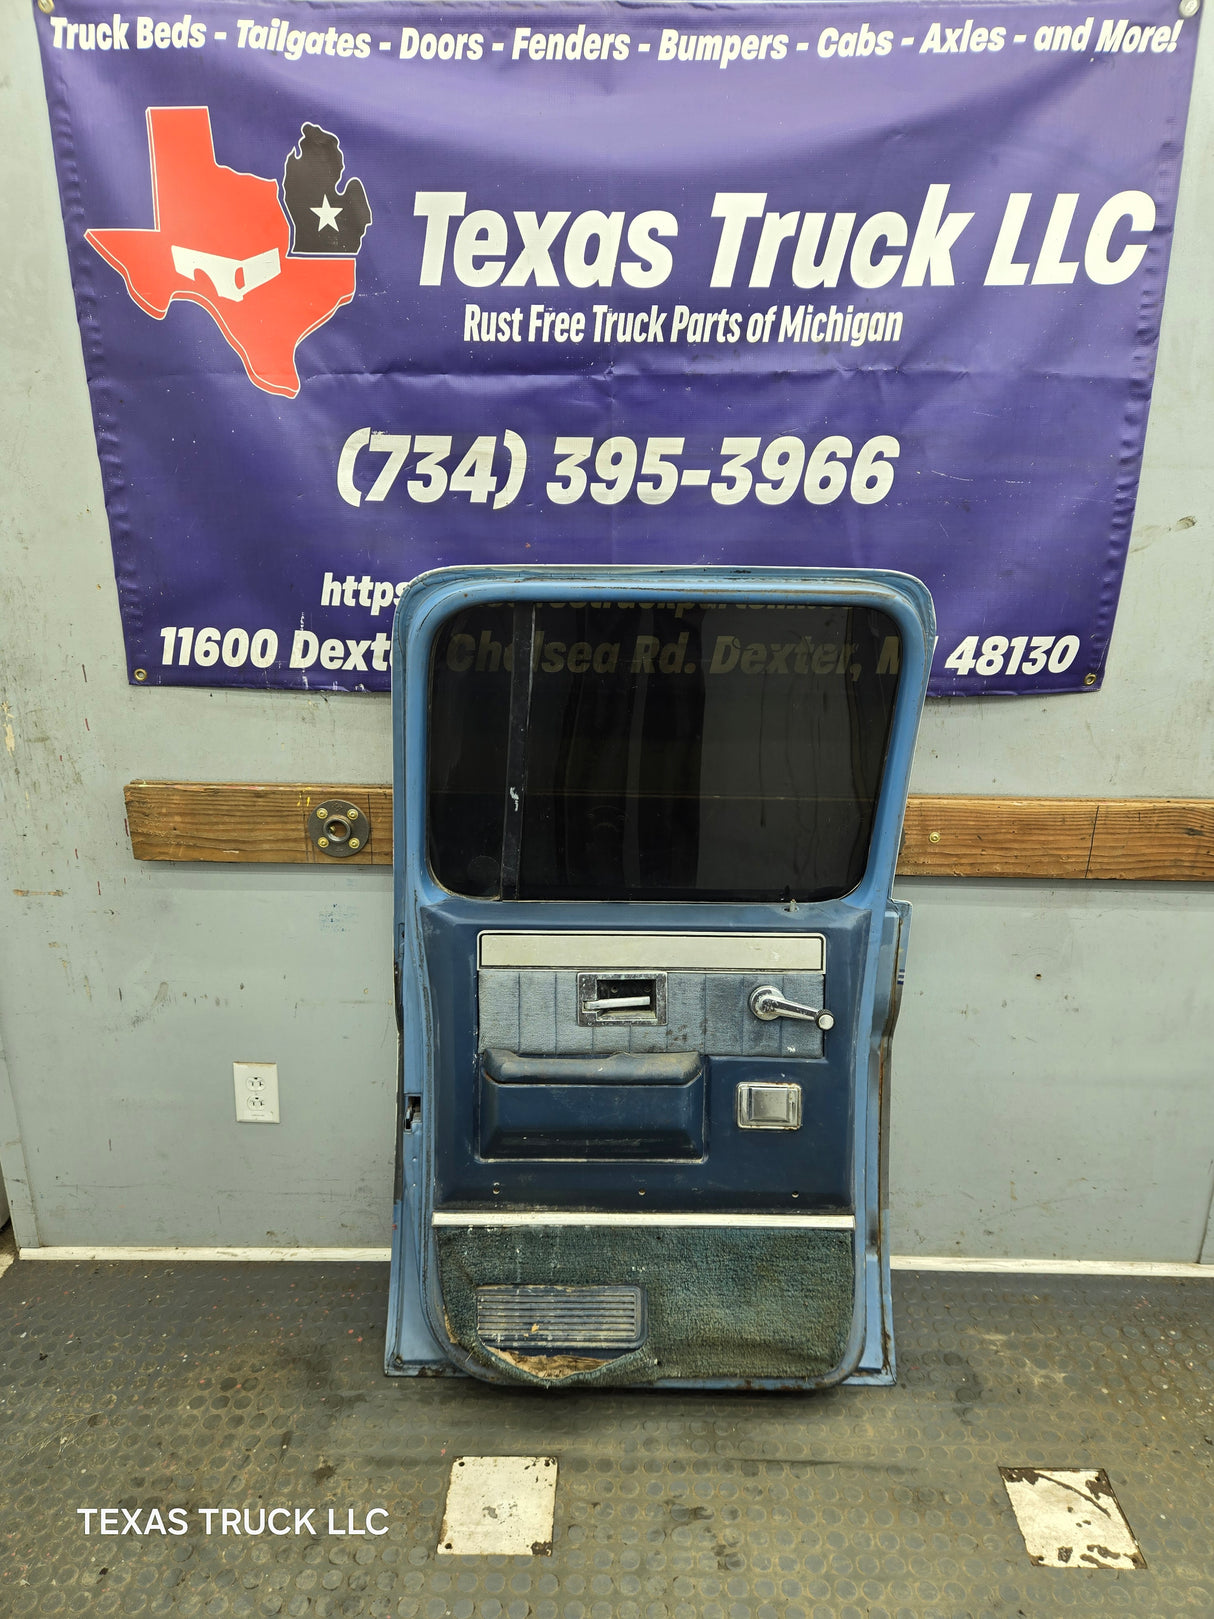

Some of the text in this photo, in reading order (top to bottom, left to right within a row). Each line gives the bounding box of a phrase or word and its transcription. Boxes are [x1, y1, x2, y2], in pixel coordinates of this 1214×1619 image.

[50, 14, 1185, 69] Truck Beds - Tailgates - Doors - Fenders - Bumpers - Cabs - Axles - and More!
[413, 183, 1157, 290] Texas Truck LLC
[463, 303, 904, 348] Rust Free Truck Parts of Michigan
[336, 426, 901, 510] (734) 395-3966
[159, 626, 279, 669] 11600
[288, 627, 392, 672] Dext
[630, 631, 697, 675] Rd.
[709, 635, 862, 682] Dexter,
[943, 634, 1080, 676] 48130
